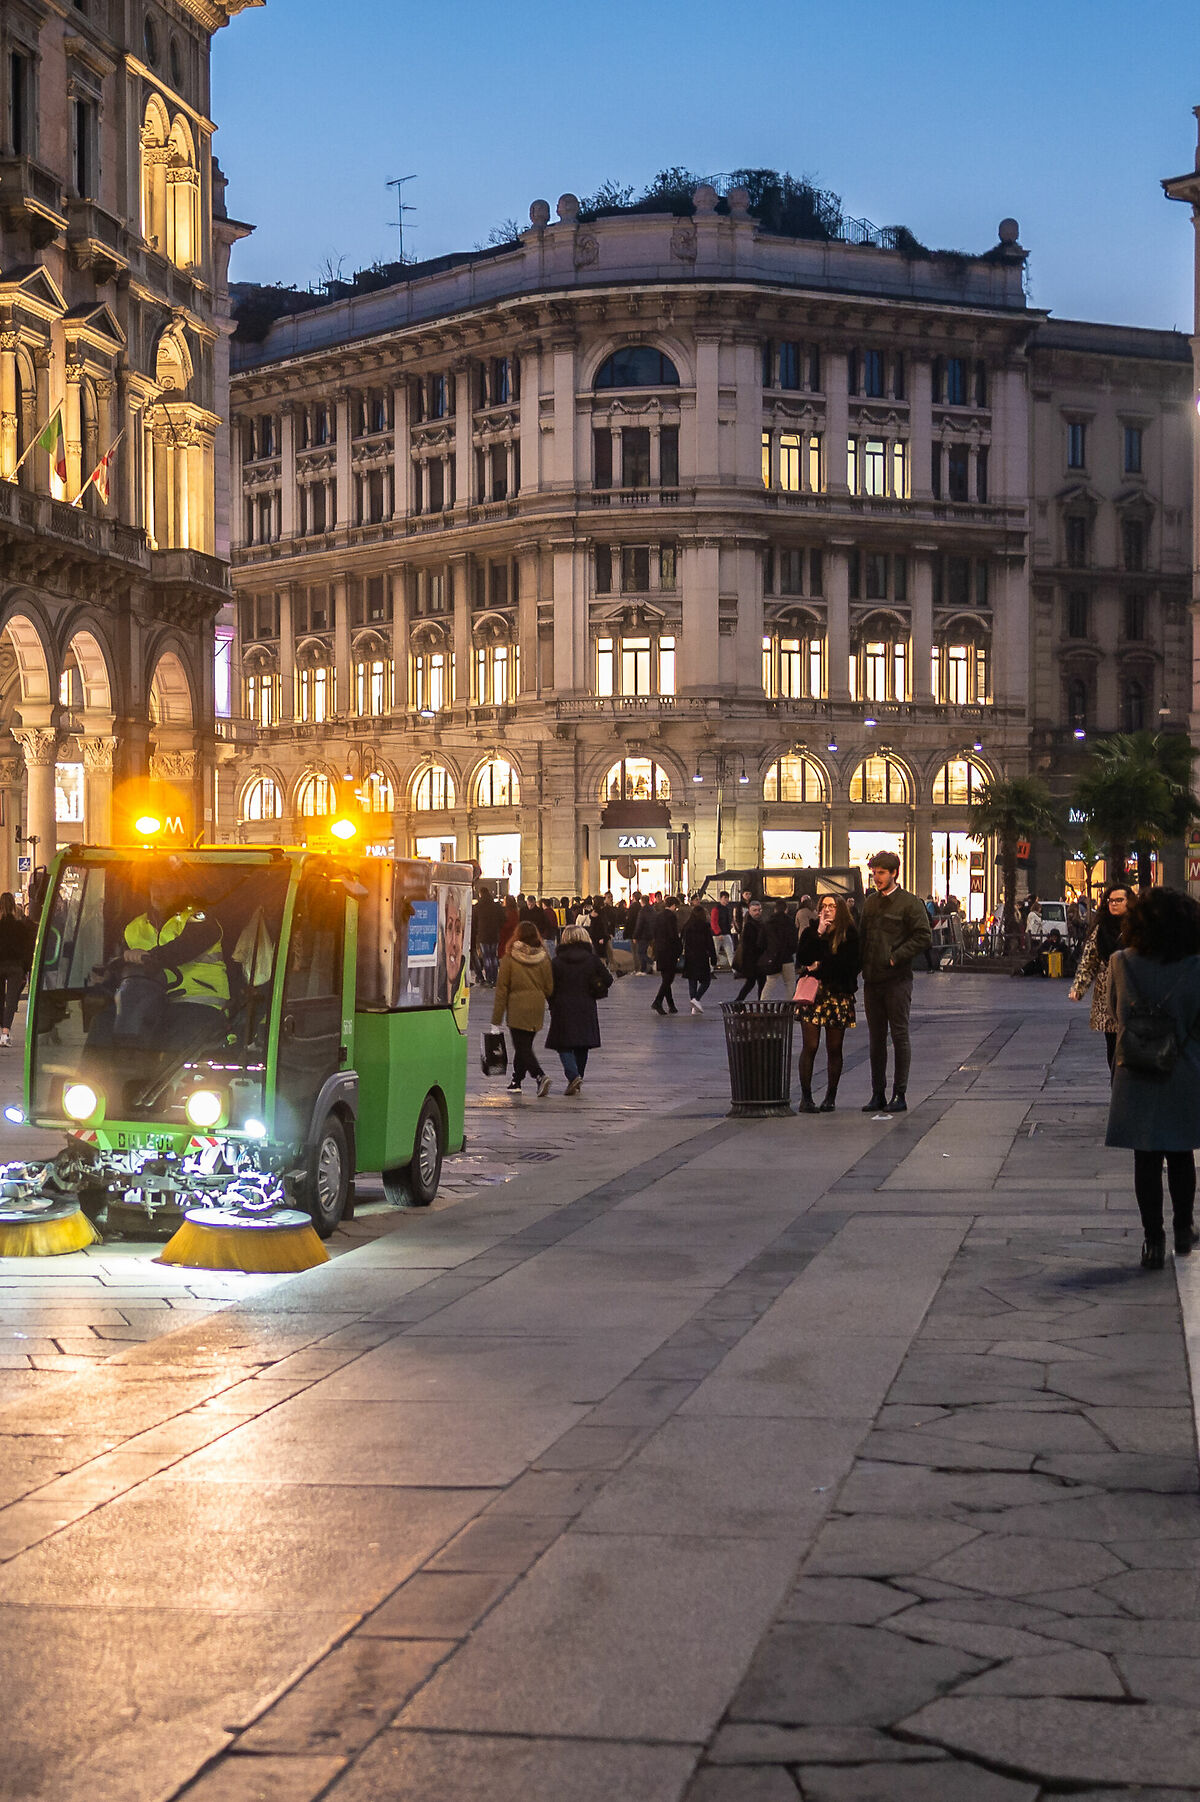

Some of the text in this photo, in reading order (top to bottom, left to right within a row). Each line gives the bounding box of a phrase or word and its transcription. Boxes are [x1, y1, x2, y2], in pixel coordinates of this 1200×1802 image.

[163, 816, 185, 834] M
[619, 835, 657, 848] ZARA
[971, 879, 982, 890] M
